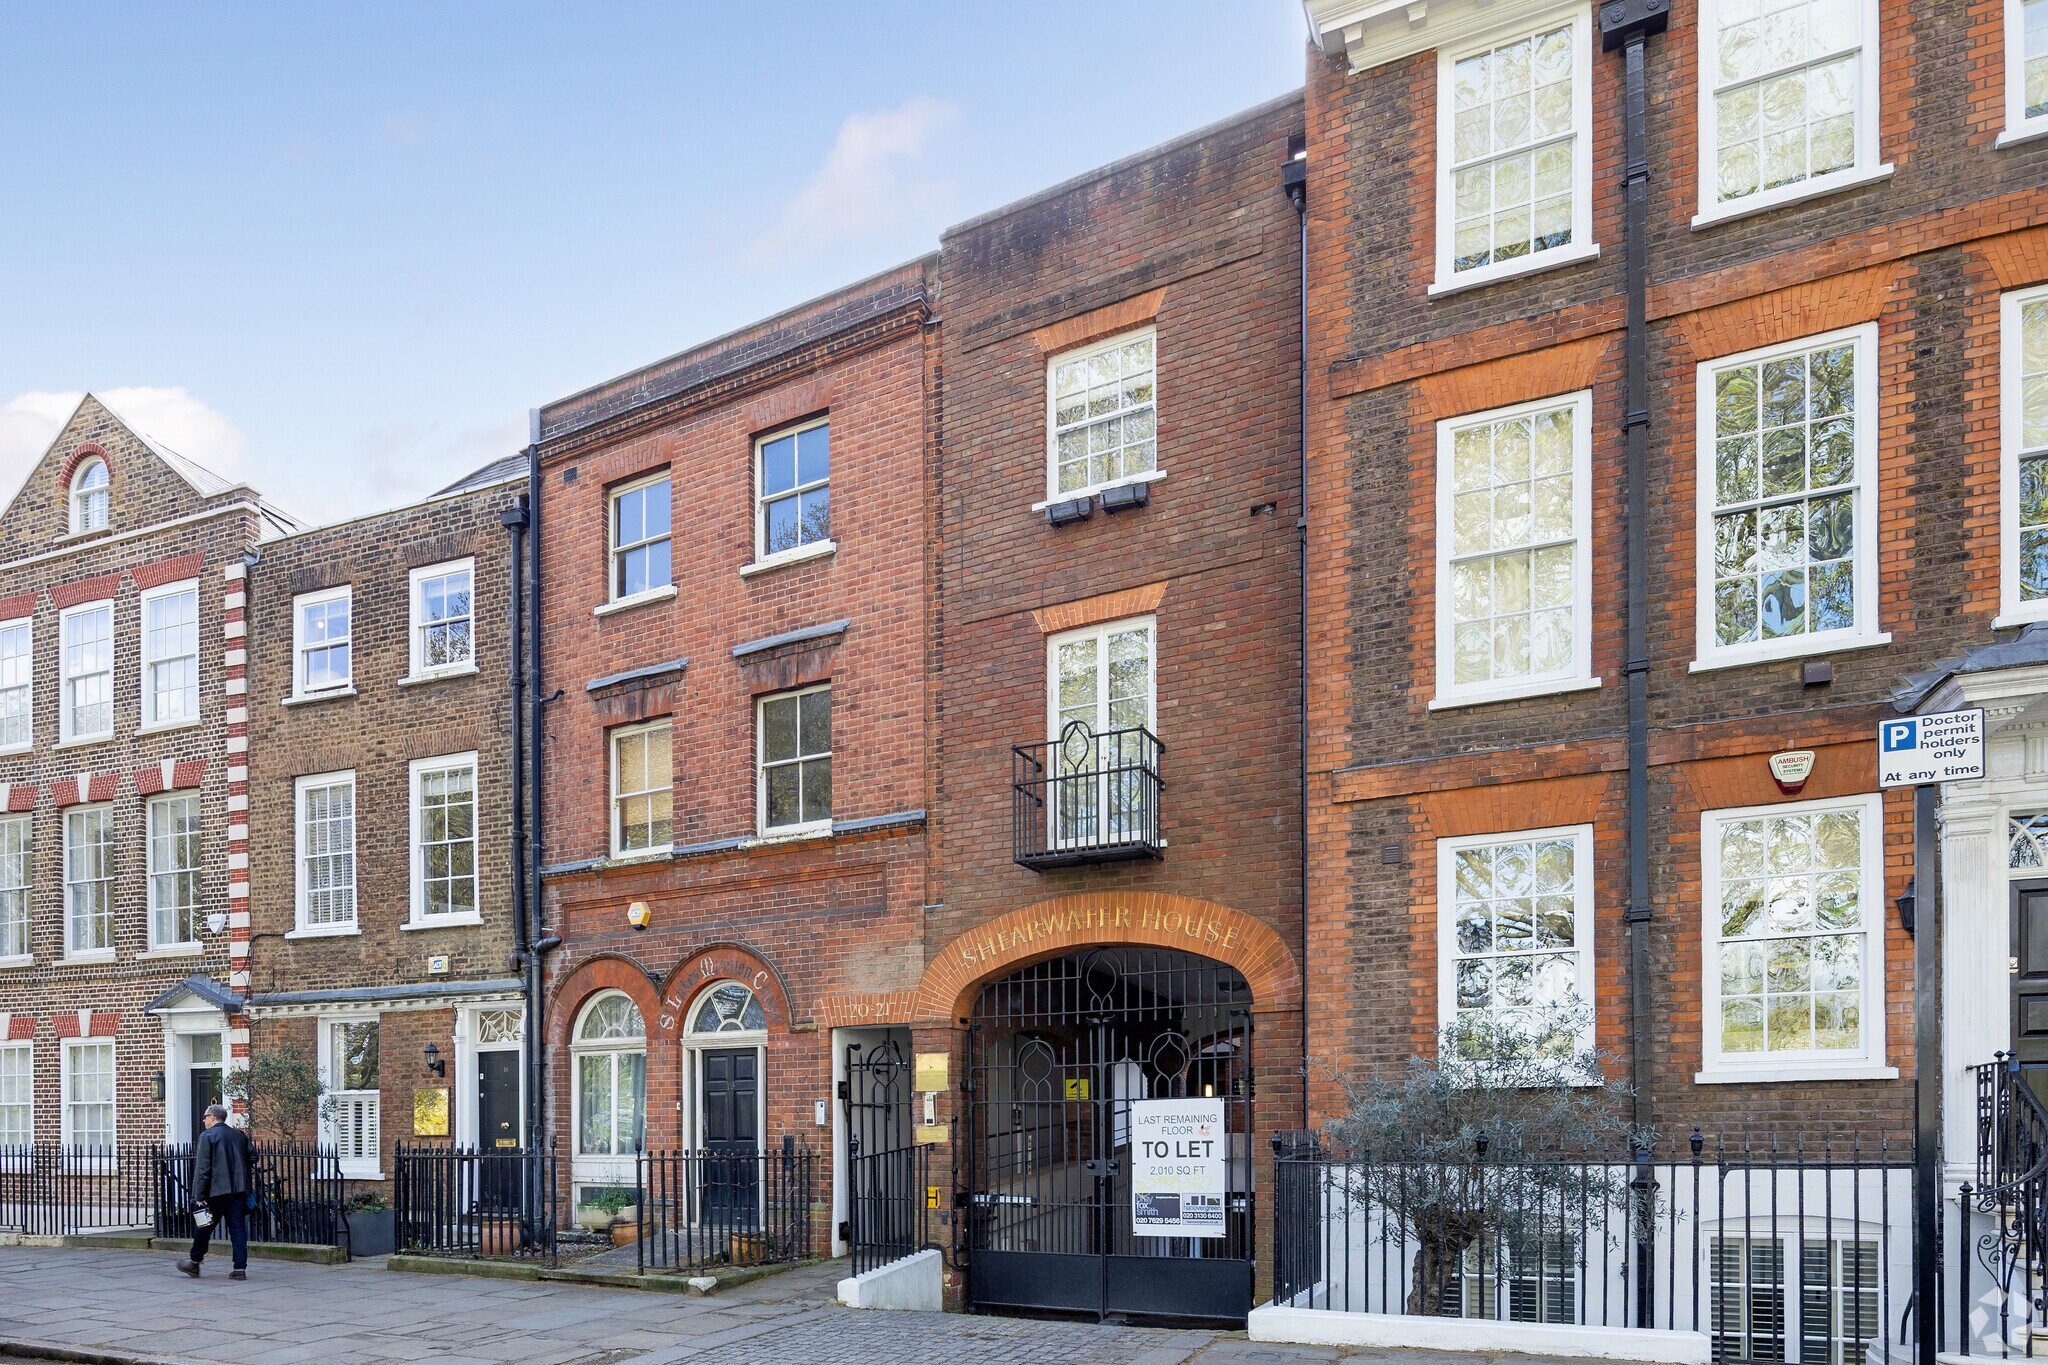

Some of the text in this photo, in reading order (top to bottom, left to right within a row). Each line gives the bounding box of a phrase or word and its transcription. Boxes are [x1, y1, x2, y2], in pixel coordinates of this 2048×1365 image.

[1922, 713, 1977, 727] Doctor
[1891, 726, 1909, 748] P
[1924, 724, 1976, 739] permit
[1920, 736, 1980, 749] holders
[1933, 748, 1966, 759] only
[1777, 756, 1809, 765] AMBUSH
[1884, 765, 1980, 782] At any time
[963, 905, 1239, 968] SHEARWATER HOUSE
[850, 1001, 890, 1018] 20-21
[1138, 1114, 1218, 1125] LAST REMAINING
[1161, 1126, 1194, 1135] FLOOR
[1142, 1140, 1214, 1158] TO LET
[1150, 1165, 1206, 1176] 2,010 SQ FT
[1136, 1201, 1150, 1209] fox
[1136, 1207, 1159, 1216] smith
